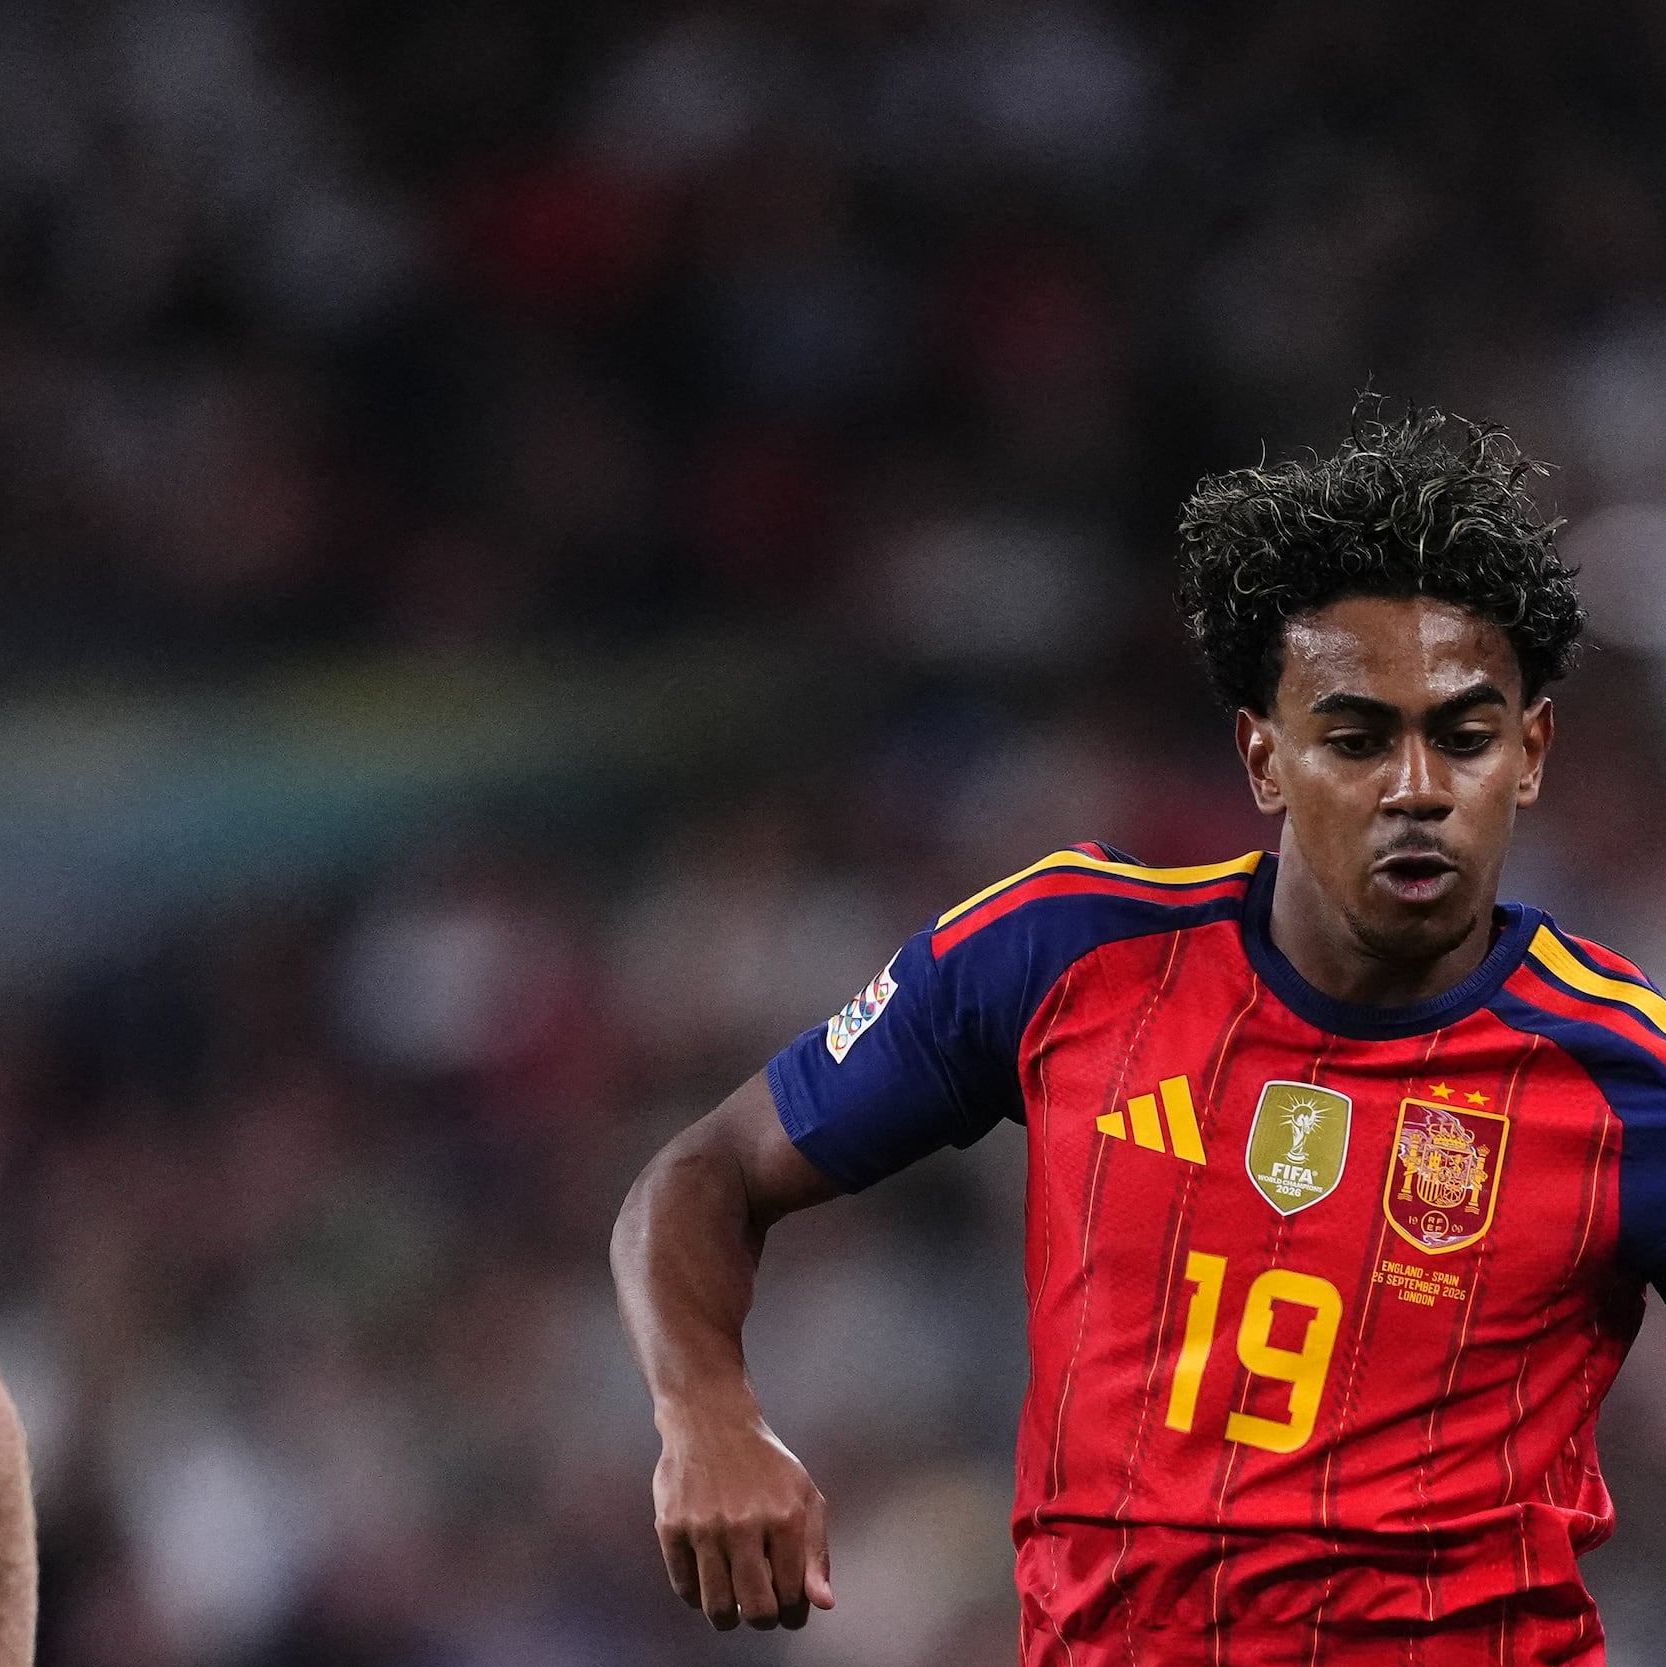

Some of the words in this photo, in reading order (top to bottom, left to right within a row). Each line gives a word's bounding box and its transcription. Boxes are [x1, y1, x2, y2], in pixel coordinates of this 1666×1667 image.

[1257, 1174, 1282, 1185] WORLD
[1282, 1179, 1324, 1193] CHAMPIONS
[1271, 1162, 1313, 1185] FIFA
[1276, 1185, 1302, 1198] 2026
[1381, 1260, 1424, 1279] ENGLAND
[1431, 1271, 1460, 1287] SPAIN
[1372, 1271, 1384, 1283] 26
[1386, 1274, 1441, 1296] SEPTEMBER
[1442, 1286, 1467, 1301] 2026
[1398, 1289, 1435, 1307] LONDON
[1165, 1250, 1343, 1454] 19
